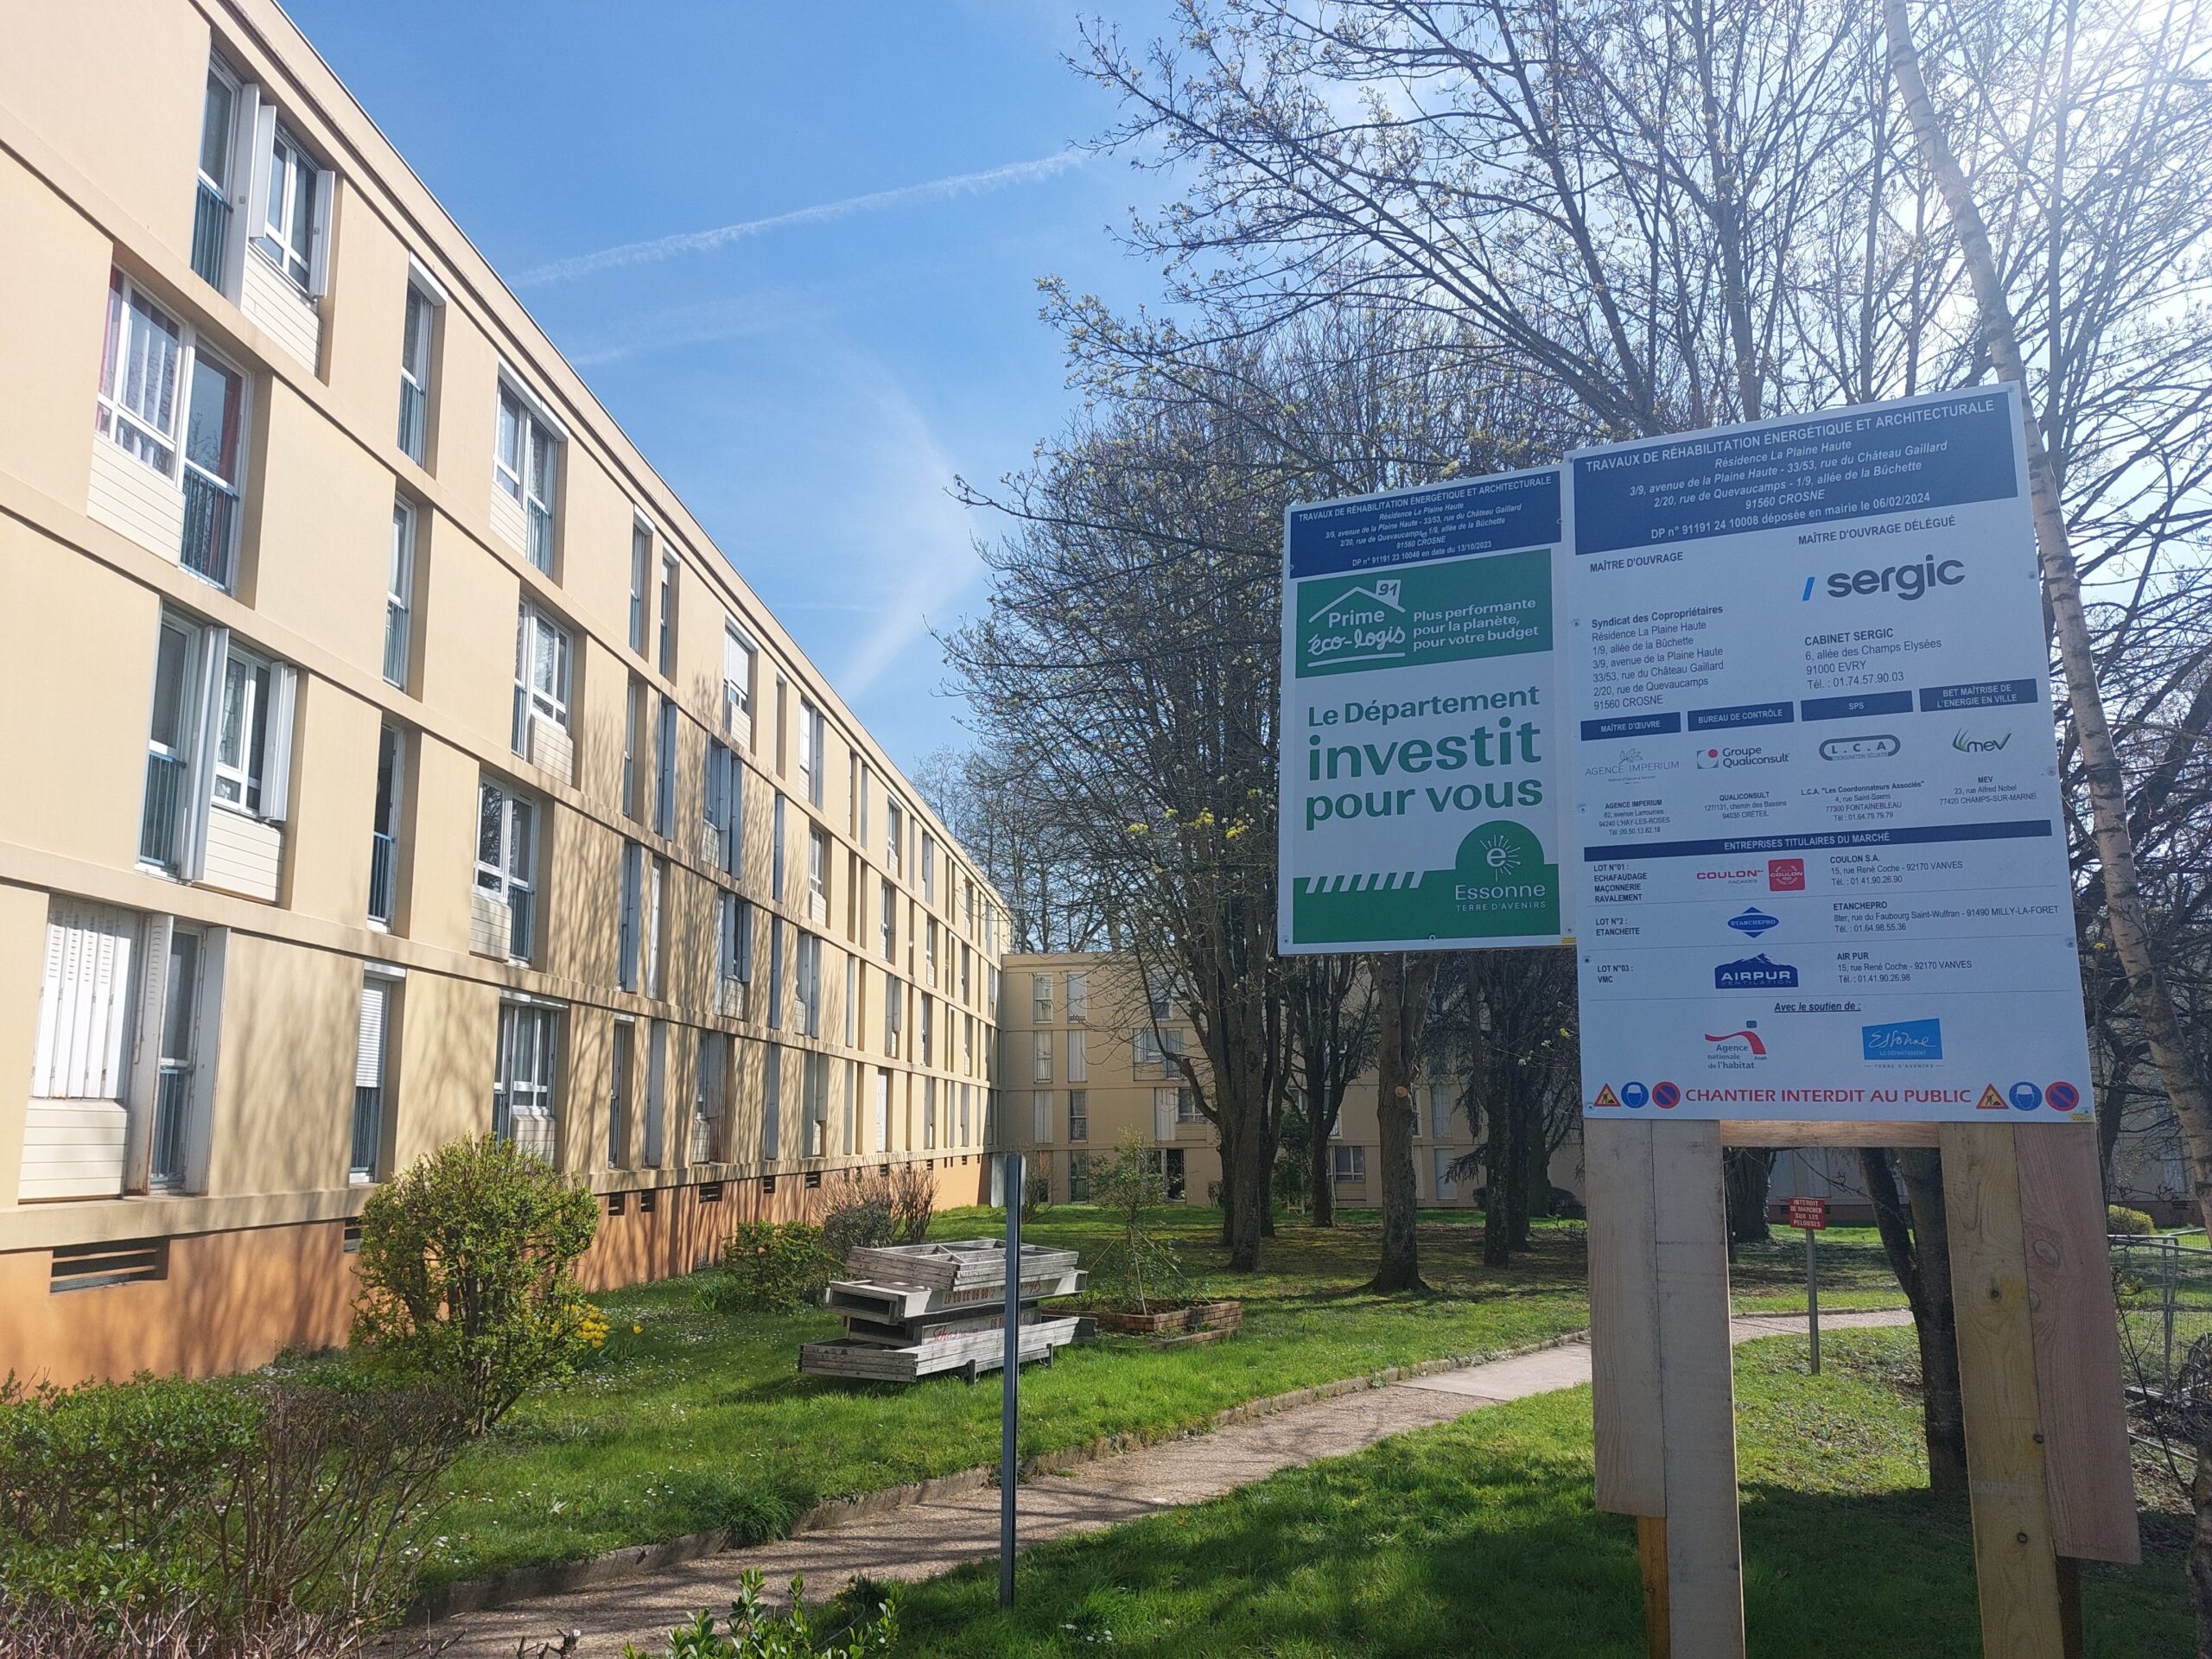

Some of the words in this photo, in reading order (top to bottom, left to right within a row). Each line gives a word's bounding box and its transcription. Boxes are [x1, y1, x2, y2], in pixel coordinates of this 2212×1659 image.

[1585, 453, 1640, 472] TRAVAUX
[1643, 450, 1659, 463] DE
[1662, 435, 1760, 460] RÉHABILITATION
[1764, 421, 1852, 445] ÉNERGÉTIQUE
[1856, 418, 1871, 431] ET
[1875, 399, 1994, 428] ARCHITECTURALE
[1714, 453, 1768, 468] Résidence
[1770, 450, 1783, 460] La
[1785, 445, 1818, 458] Plaine
[1820, 440, 1852, 452] Haute
[1745, 496, 1775, 510] 91560
[1778, 488, 1825, 505] CROSNE
[1650, 527, 1665, 539] DP
[1681, 521, 1710, 535] 91191
[1714, 519, 1726, 530] 24
[1728, 515, 1759, 528] 10008
[1761, 509, 1805, 524] déposée
[1808, 508, 1821, 517] en
[1824, 502, 1857, 515] mairie
[1860, 500, 1870, 510] le
[1872, 491, 1930, 509] 06/02/2024
[1798, 531, 1836, 545] MAÎTRE
[1839, 522, 1901, 540] D'OUVRAGE
[1904, 514, 1956, 531] DÉLÉGUÉ
[1589, 559, 1624, 572] MAÎTRE
[1626, 551, 1683, 567] D'OUVRAGE
[1826, 553, 1965, 601] sergic
[1377, 582, 1398, 596] 91
[1328, 609, 1385, 628] Prime
[1413, 610, 1442, 622] Plus
[1445, 599, 1536, 621] performante
[1591, 615, 1630, 630] Syndicat
[1632, 614, 1649, 623] des
[1651, 605, 1723, 622] Copropriétaires
[1413, 624, 1445, 638] pour
[1448, 620, 1460, 631] la
[1463, 615, 1520, 632] planète,
[1413, 638, 1446, 652] pour
[1448, 633, 1484, 645] votre
[1487, 626, 1538, 640] budget
[1804, 632, 1850, 646] CABINET
[1853, 627, 1893, 641] SERGIC
[1805, 650, 1814, 661] 6,
[1816, 649, 1839, 659] allée
[1841, 647, 1859, 657] des
[1861, 643, 1901, 655] Champs
[1903, 638, 1942, 652] Elysées
[1806, 662, 1835, 675] 91000
[1838, 659, 1866, 672] EVRY
[1806, 678, 1825, 689] Tél.
[1832, 670, 1904, 687] 01.74.57.90.03
[1942, 685, 1958, 697] BET
[2000, 683, 2011, 692] DE
[1308, 706, 1338, 727] Le
[1344, 685, 1540, 726] Département
[1593, 698, 1620, 710] 91560
[1622, 694, 1663, 707] CROSNE
[1848, 701, 1864, 710] SPS
[1979, 696, 1992, 706] EN
[1994, 693, 2017, 702] VILLE
[1698, 714, 1728, 724] BUREAU
[1730, 712, 1740, 720] DE
[1742, 708, 1782, 719] CONTRÔLE
[1309, 716, 1541, 781] investit
[1964, 732, 2011, 753] mev
[1722, 747, 1762, 757] Groupe
[1584, 764, 1624, 776] AGENCE
[1629, 760, 1679, 772] IMPERIUM
[1722, 752, 1789, 769] Qualiconsult
[1306, 788, 1416, 831] pour
[1424, 779, 1543, 812] vous
[1723, 838, 1783, 850] ENTREPRISES
[1784, 835, 1835, 846] TITULAIRES
[1837, 835, 1849, 843] DU
[1829, 854, 1863, 864] COULON
[1865, 854, 1880, 862] S.A.
[1696, 869, 1757, 879] COULON
[1831, 866, 1841, 875] 15,
[1856, 865, 1875, 873] René
[1876, 864, 1900, 872] Coche
[1906, 862, 1929, 871] 92170
[1929, 860, 1963, 870] VANVES
[1593, 871, 1647, 882] ECHAFAUDAGE
[1455, 884, 1545, 900] Essonne
[1594, 882, 1641, 894] MAÇONNERIE
[1455, 903, 1487, 911] TERRE
[1491, 900, 1546, 910] D'AVENIRS
[1594, 892, 1642, 904] RAVALEMENT
[1833, 900, 1888, 911] ETANCHEPRO
[1875, 912, 1909, 921] Faubourg
[1966, 908, 1990, 917] 91490
[1991, 905, 2058, 915] MILLY-LA-FORET
[1729, 918, 1778, 928] ETANCHEPRO
[1836, 952, 1852, 960] AIR
[1850, 951, 1869, 960] PUR
[1721, 970, 1790, 981] AIRPUR
[1774, 1002, 1796, 1012] Avec
[1798, 1002, 1806, 1011] le
[1808, 1000, 1843, 1011] soutien
[1841, 1001, 1855, 1011] de
[1715, 1043, 1748, 1053] Agence
[1707, 1052, 1740, 1061] nationale
[1717, 1060, 1754, 1069] l'habitat
[1685, 1088, 1776, 1102] CHANTIER
[1781, 1089, 1865, 1102] INTERDIT
[1869, 1089, 1898, 1102] AU
[1904, 1089, 1971, 1103] PUBLIC
